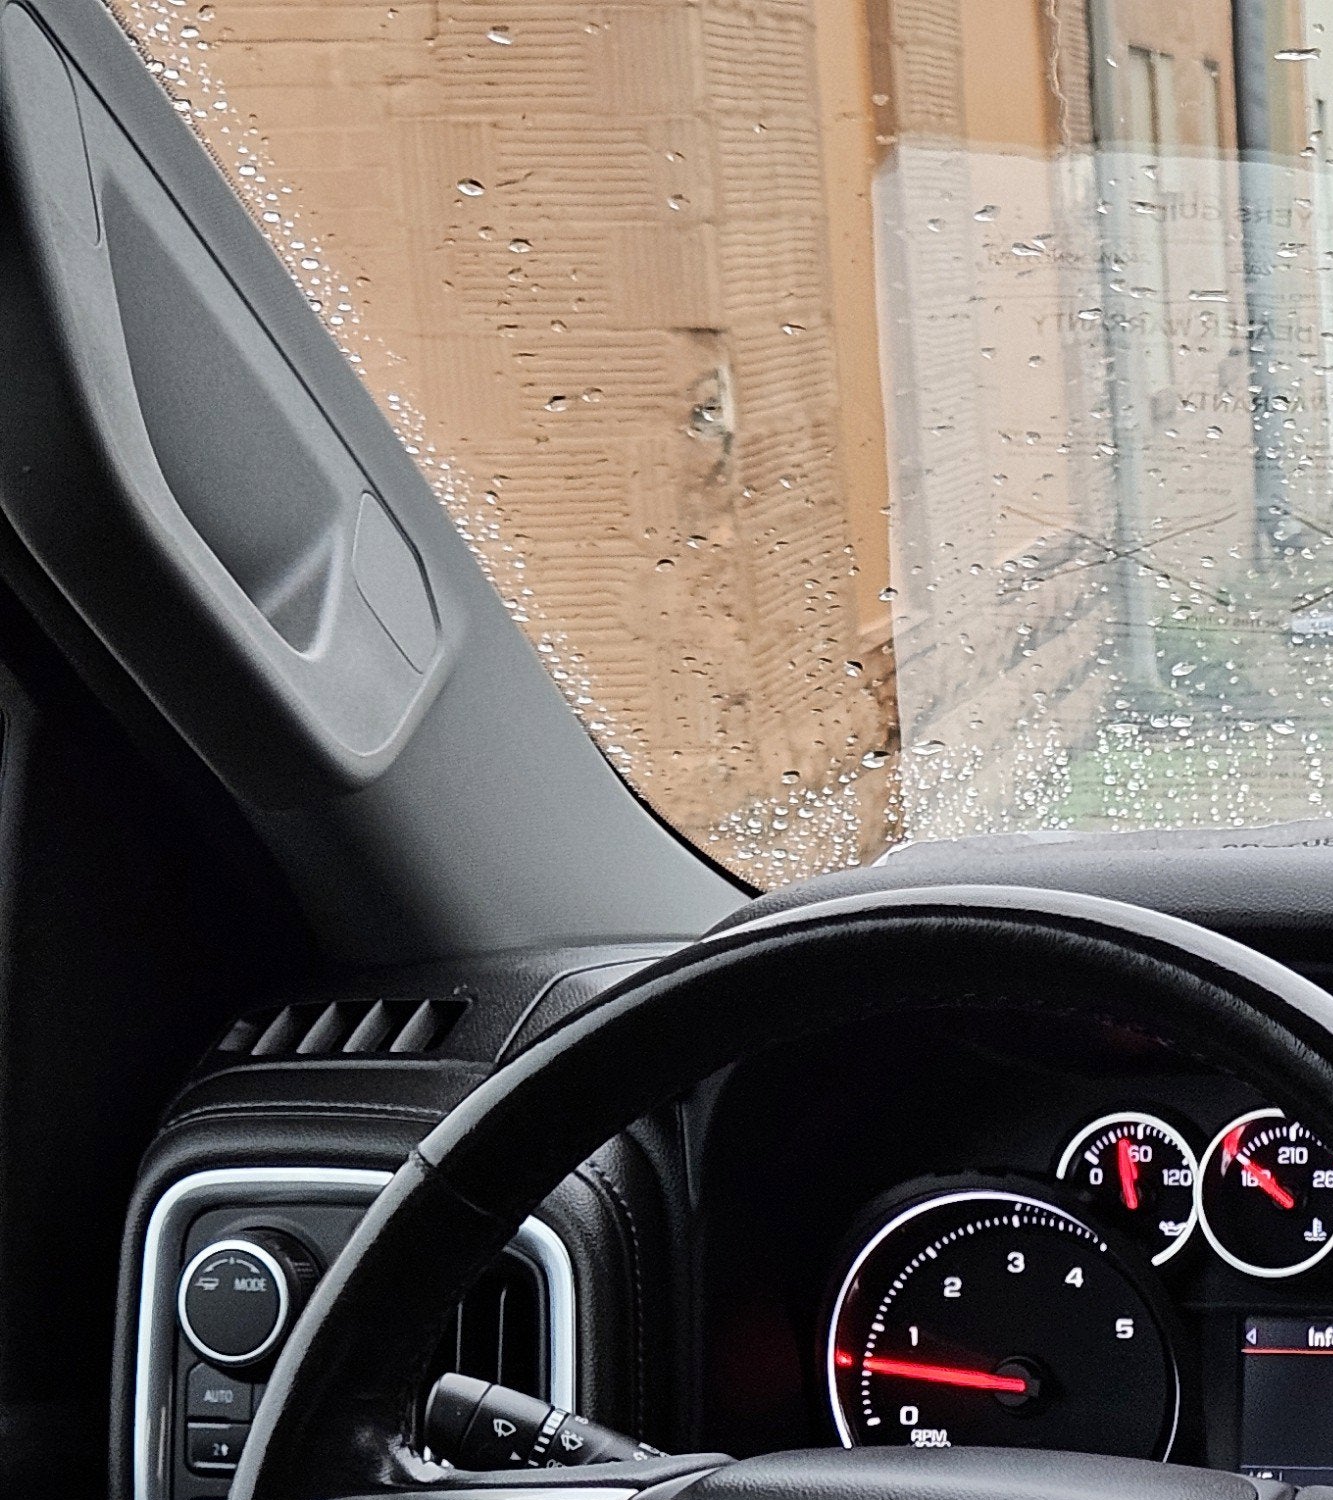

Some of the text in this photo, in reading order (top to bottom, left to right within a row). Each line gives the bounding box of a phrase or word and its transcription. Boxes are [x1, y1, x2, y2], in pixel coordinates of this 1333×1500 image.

[1277, 1146, 1308, 1165] 210
[1163, 1168, 1192, 1187] 120
[1007, 1251, 1025, 1273] 3
[233, 1278, 267, 1292] MODE
[943, 1276, 962, 1298] 2
[1064, 1267, 1084, 1288] 4
[908, 1326, 919, 1346] 1
[1115, 1318, 1134, 1339] 5
[203, 1389, 234, 1404] AUTO
[900, 1406, 920, 1425] 0
[911, 1428, 948, 1443] RPM
